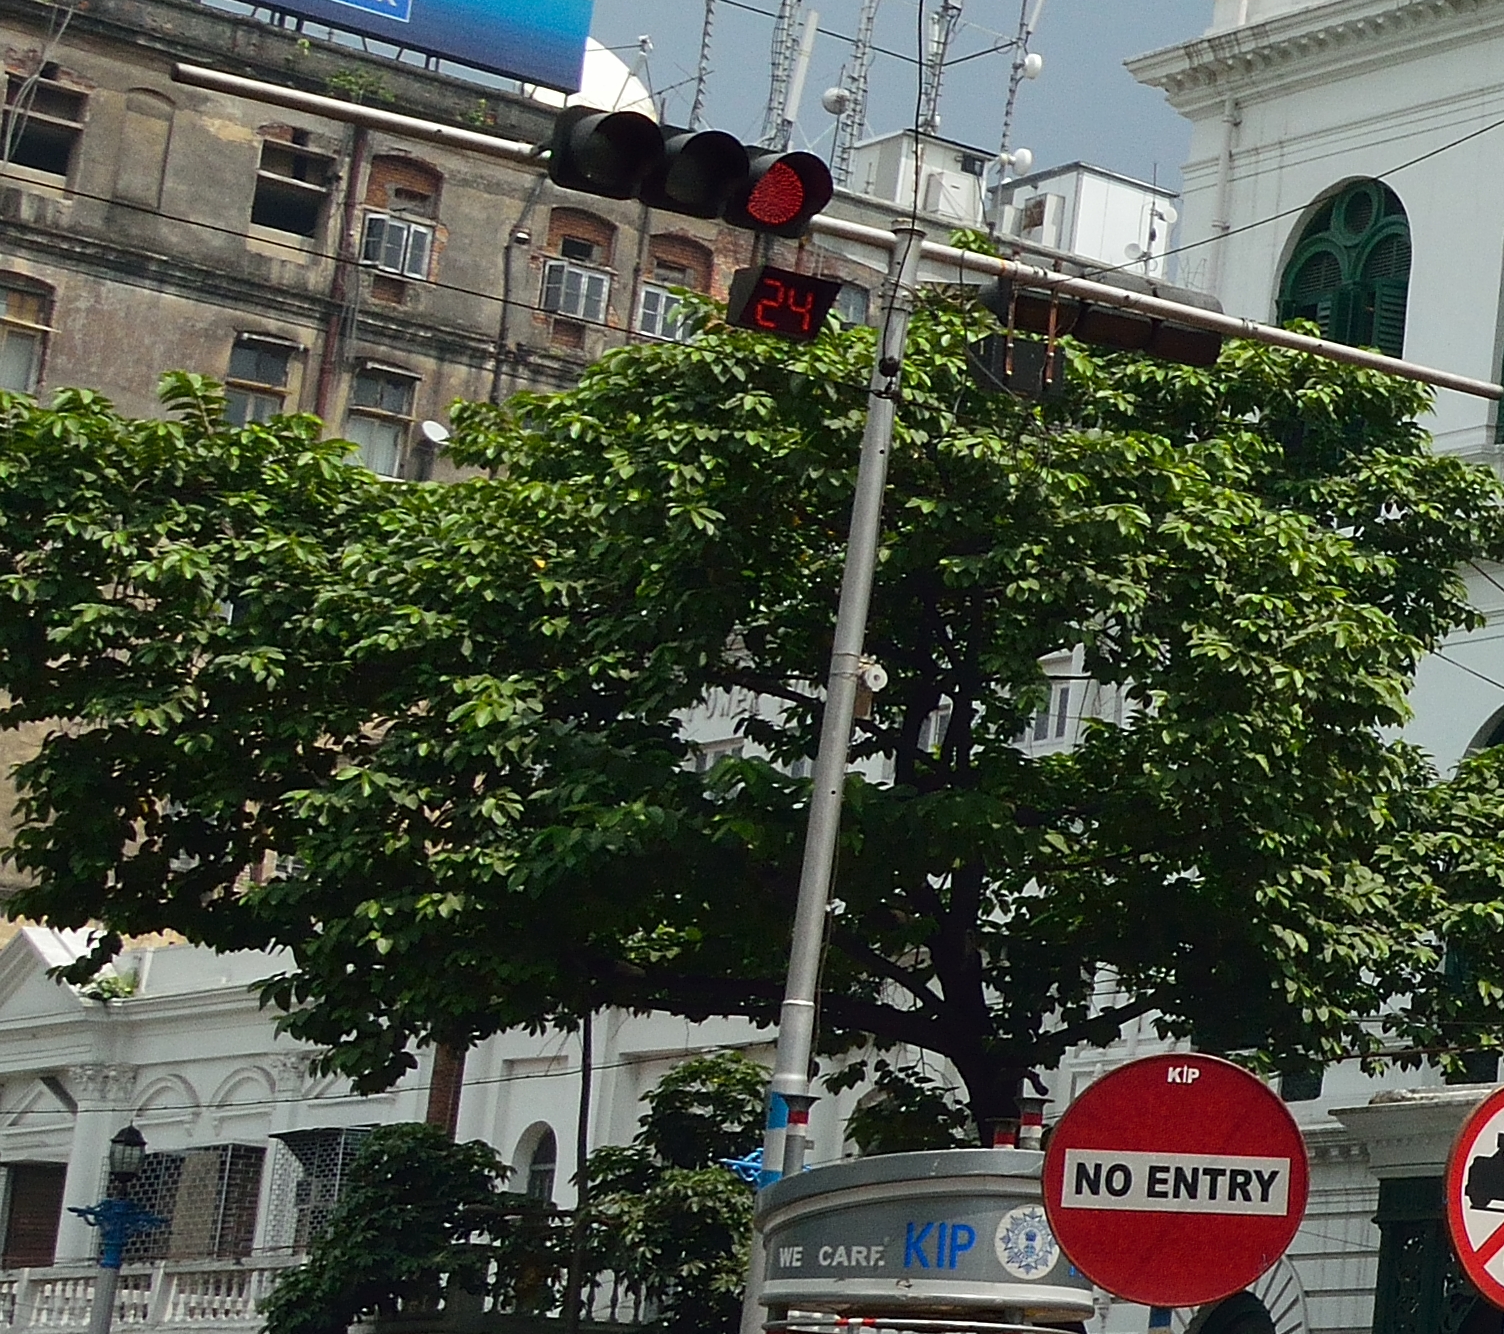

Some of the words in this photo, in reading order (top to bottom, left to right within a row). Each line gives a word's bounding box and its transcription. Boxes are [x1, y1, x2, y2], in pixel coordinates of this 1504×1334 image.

[755, 277, 815, 331] 24
[1167, 1065, 1201, 1084] KIP
[1075, 1162, 1133, 1198] NO
[1146, 1164, 1280, 1203] ENTRY
[779, 1246, 803, 1267] WE
[902, 1221, 977, 1271] KIP
